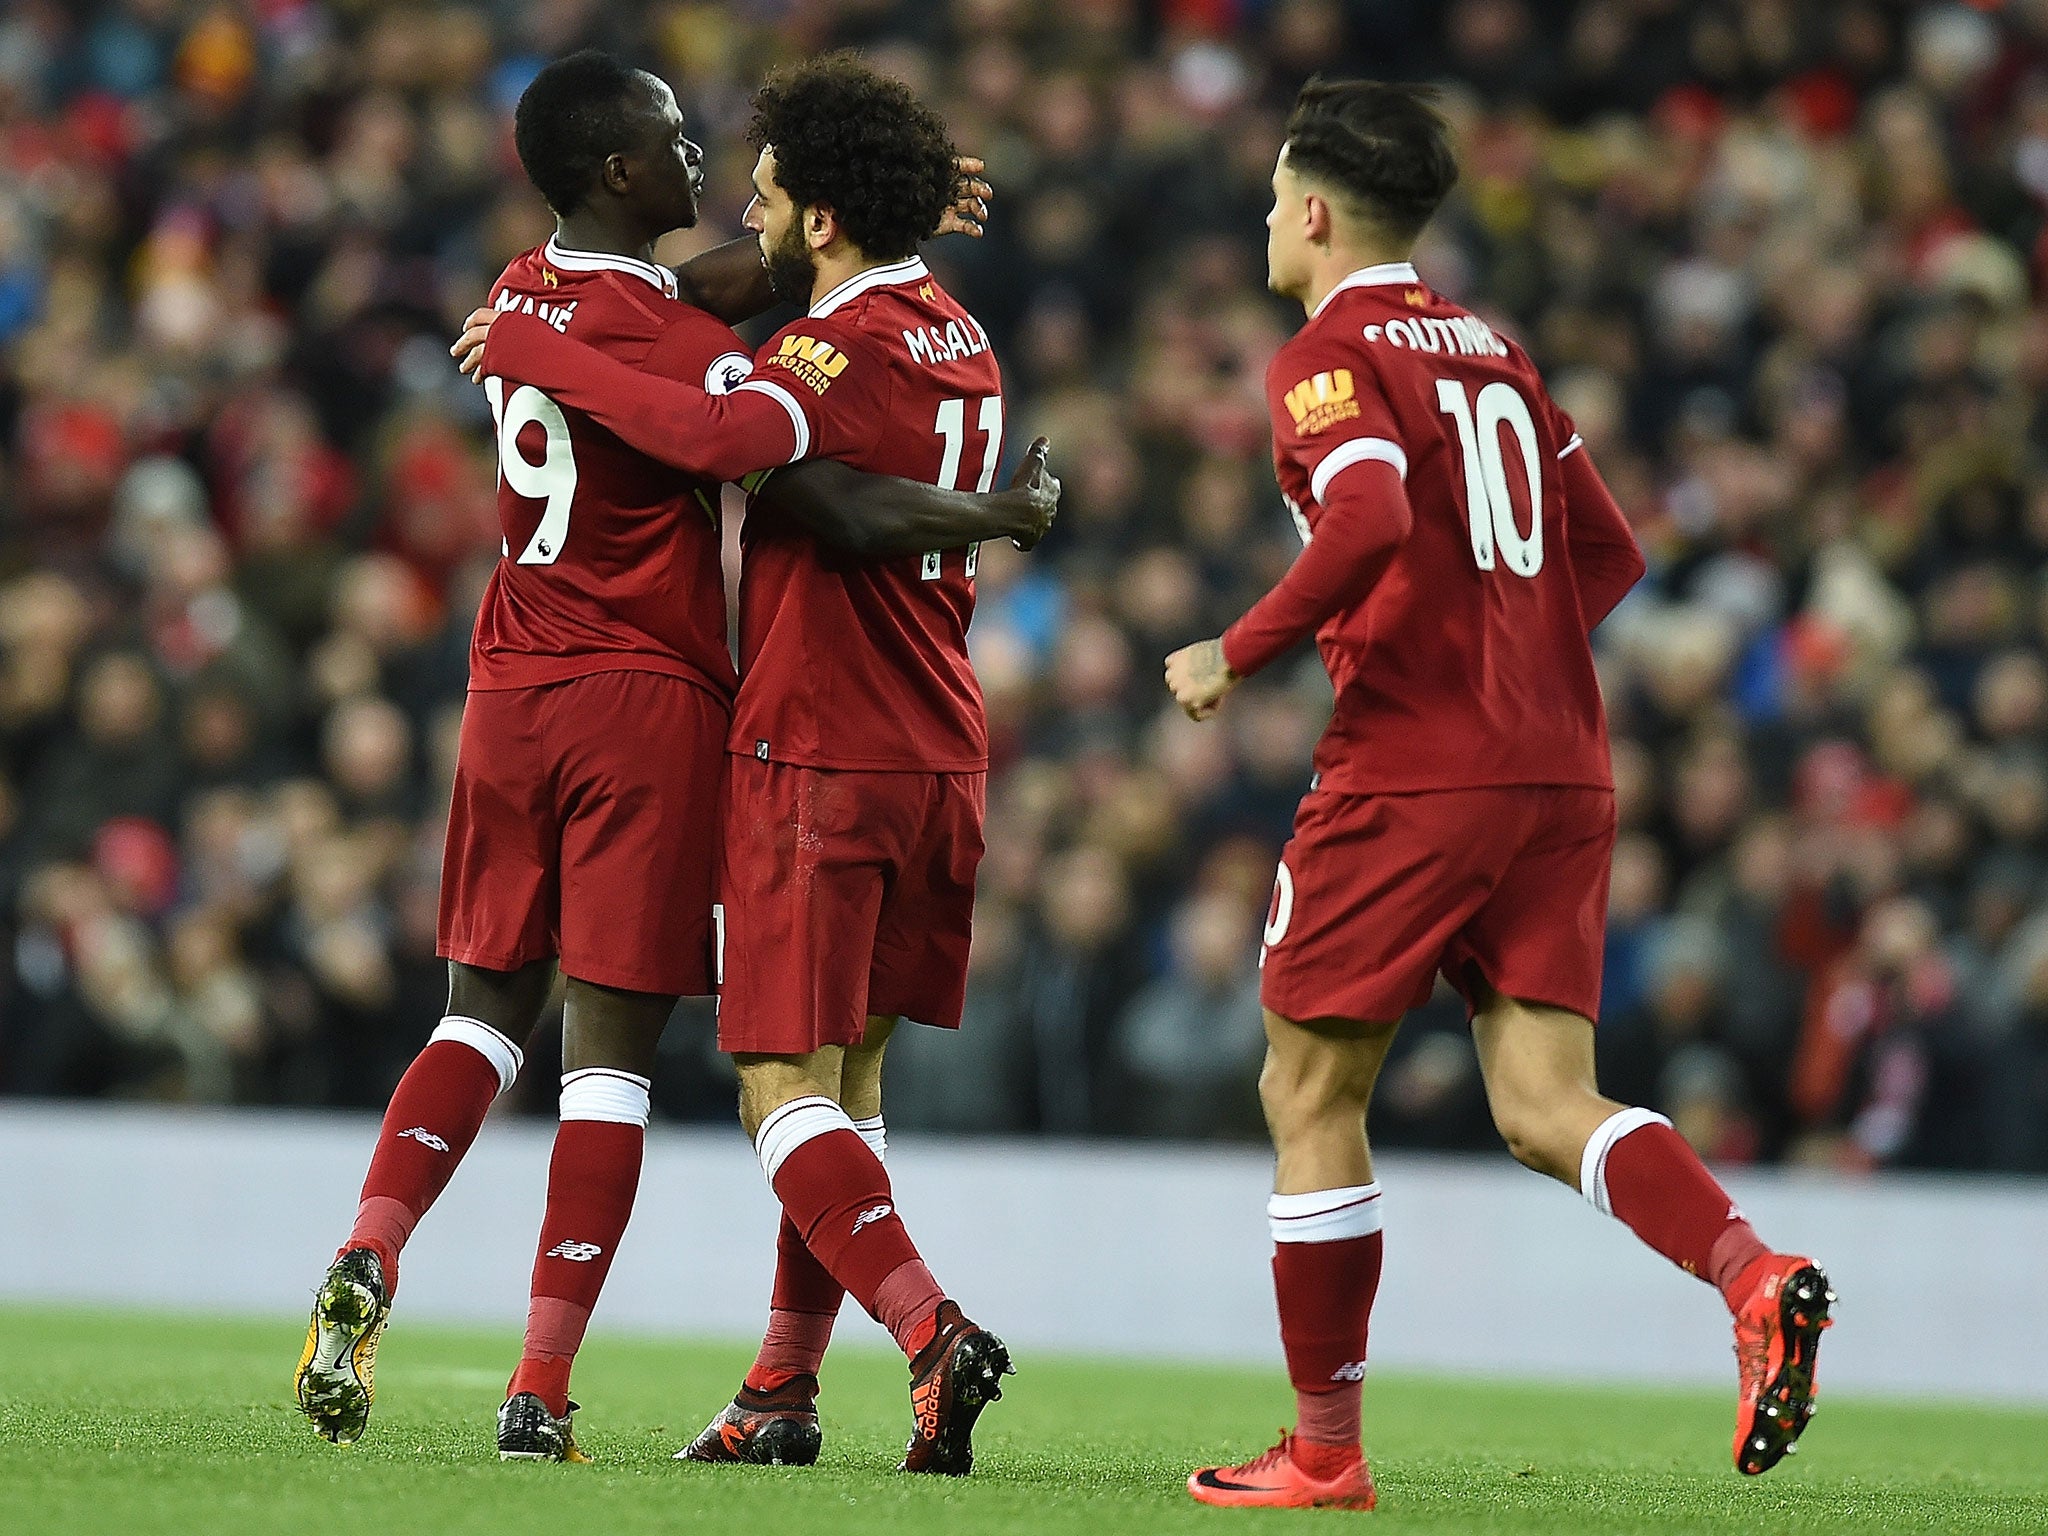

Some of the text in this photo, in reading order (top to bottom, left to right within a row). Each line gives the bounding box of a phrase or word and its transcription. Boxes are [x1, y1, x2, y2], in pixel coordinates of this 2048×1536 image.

[778, 335, 849, 378] WU
[1284, 369, 1355, 424] WU
[920, 396, 1003, 580] 11
[1435, 378, 1544, 578] 10
[924, 1373, 942, 1441] adidas
